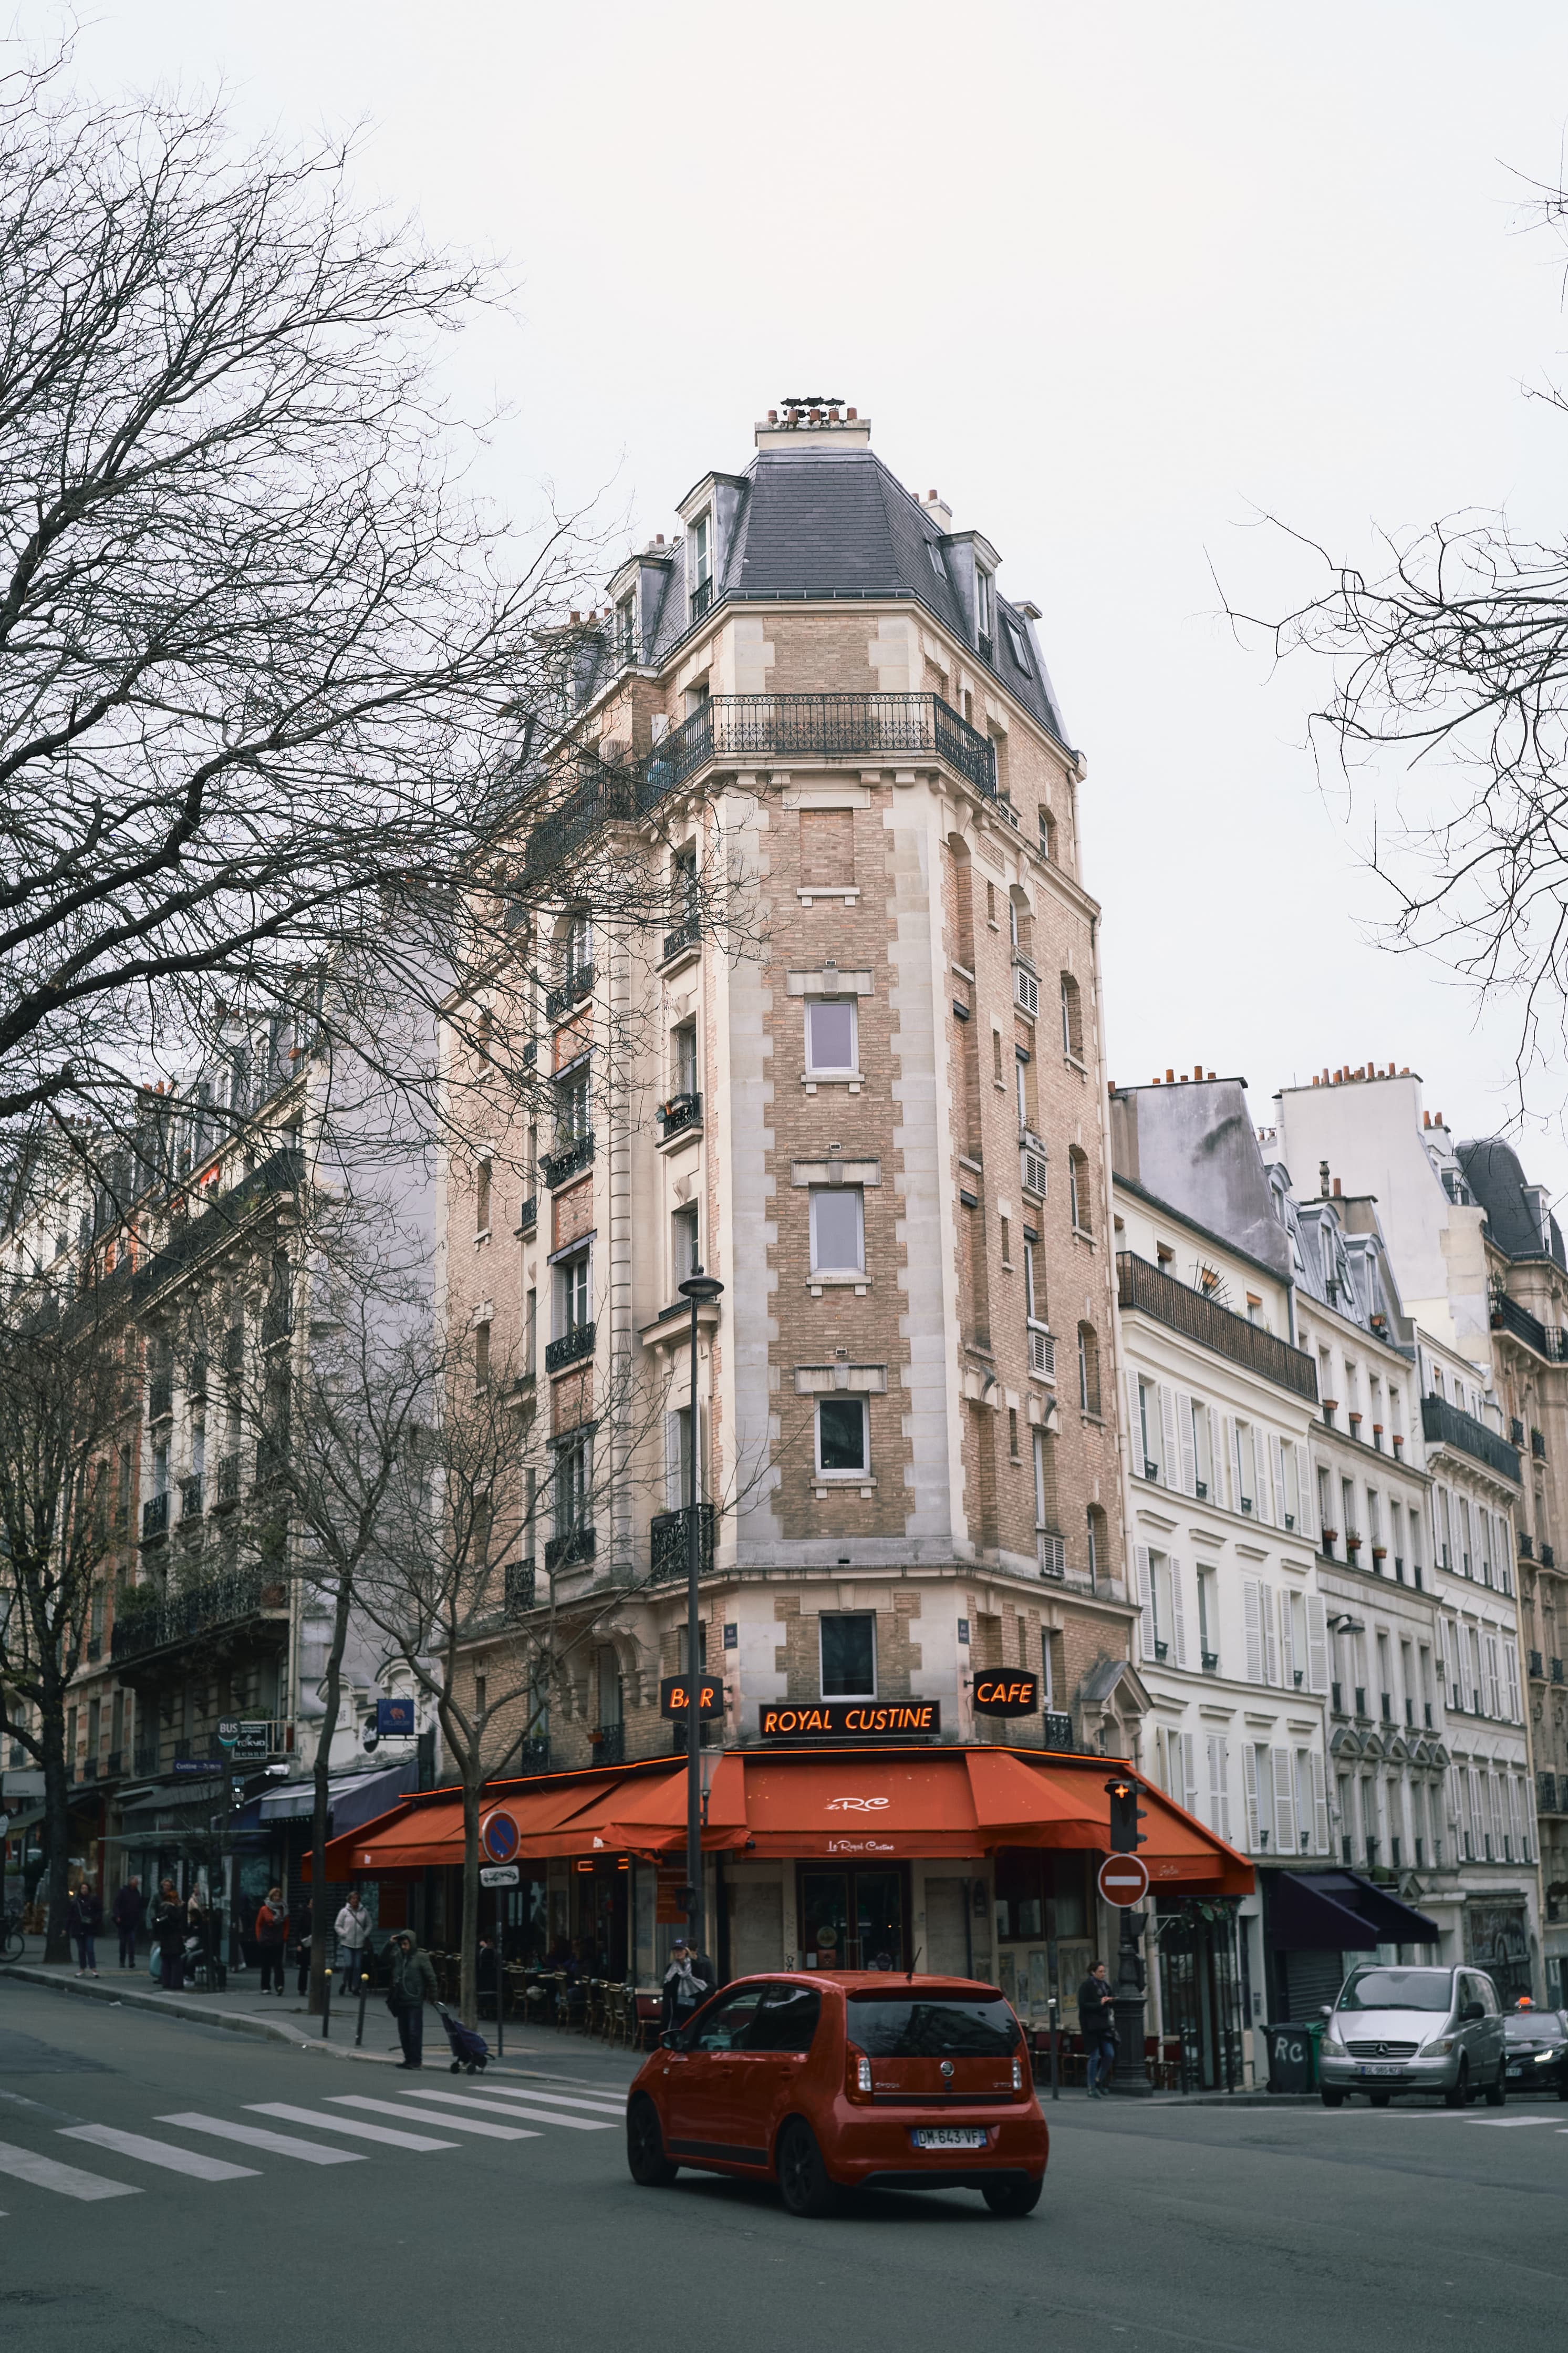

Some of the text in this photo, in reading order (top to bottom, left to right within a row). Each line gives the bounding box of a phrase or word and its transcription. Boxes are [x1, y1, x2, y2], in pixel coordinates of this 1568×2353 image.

[669, 1688, 714, 1708] BR
[977, 1683, 1033, 1703] CAFE
[220, 1723, 238, 1733] BUS
[765, 1707, 933, 1733] ROYAL CUSTINE
[1274, 2036, 1304, 2063] RC
[919, 2130, 978, 2144] DM-643-VF
